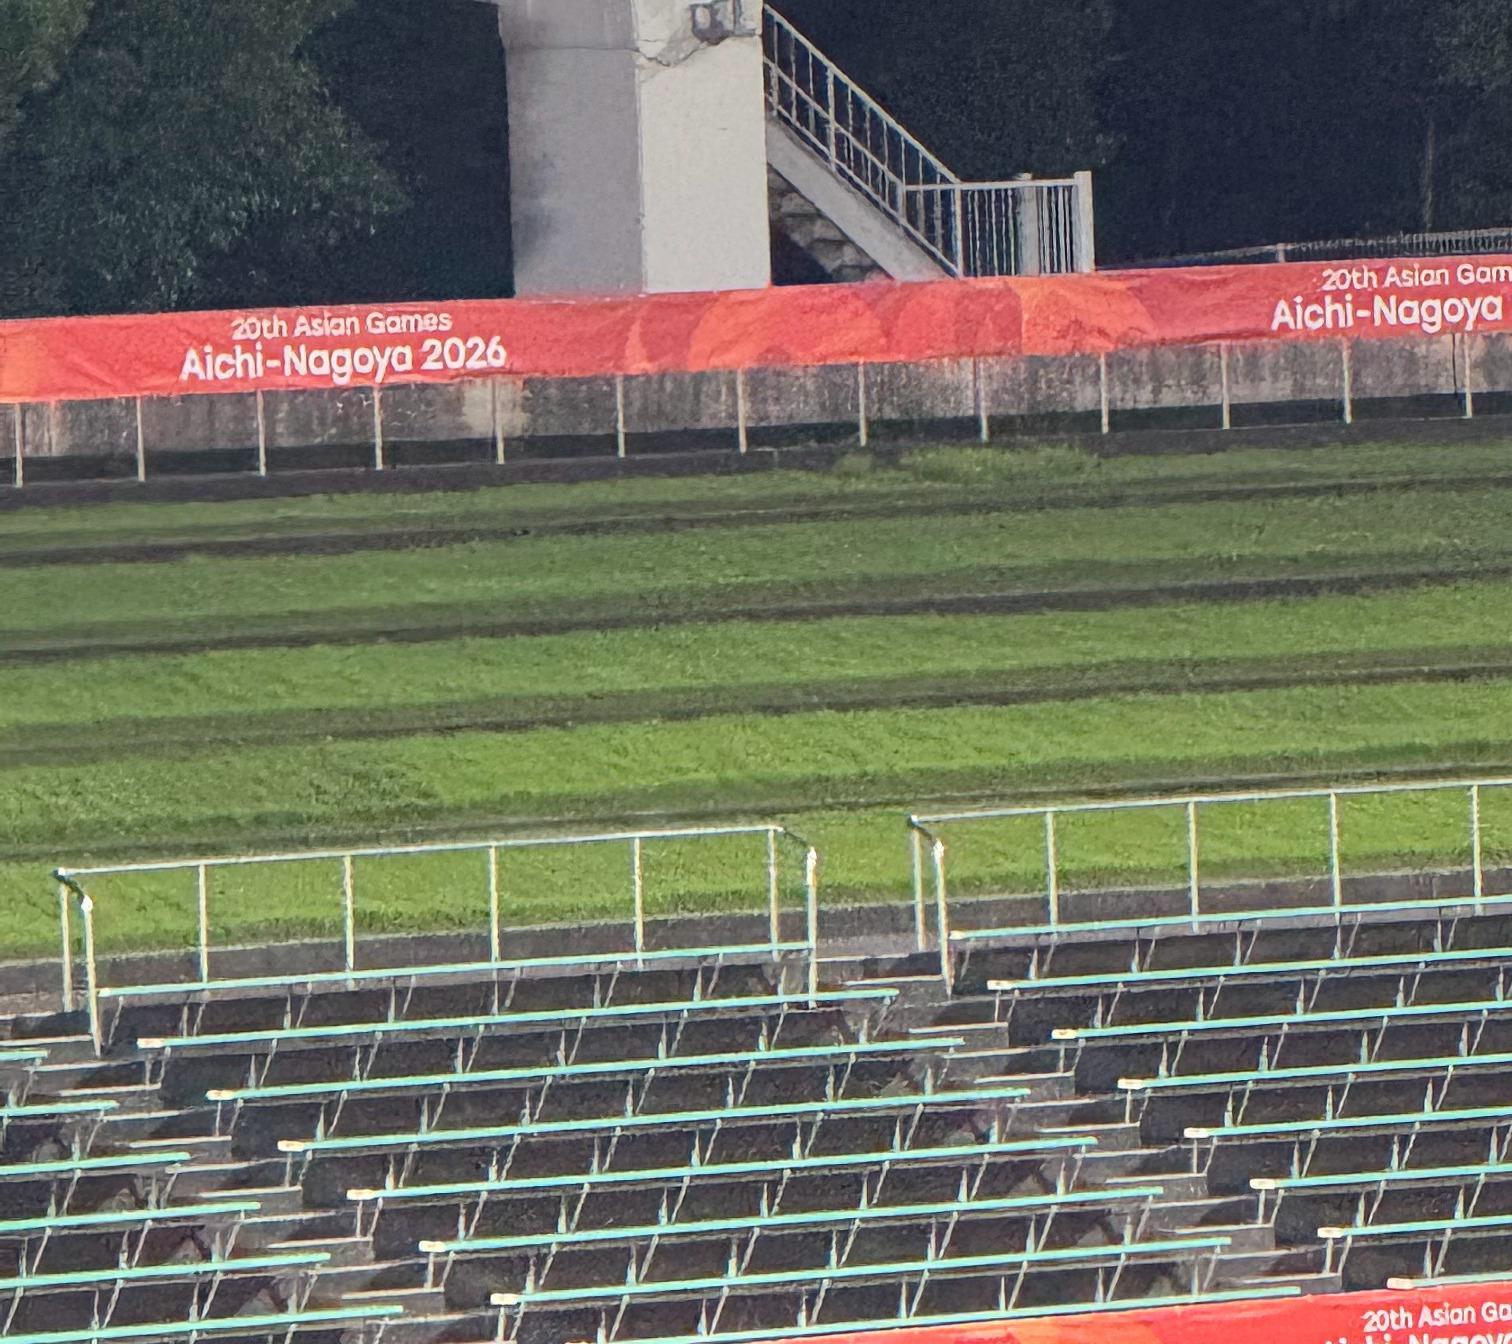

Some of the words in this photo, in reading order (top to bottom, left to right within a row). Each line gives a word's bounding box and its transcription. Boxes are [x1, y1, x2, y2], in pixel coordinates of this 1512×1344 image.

[1321, 265, 1378, 291] 20th
[1384, 264, 1450, 288] Asian
[231, 314, 289, 341] 20th
[294, 313, 361, 338] Asian
[366, 312, 453, 335] Games
[1271, 293, 1503, 334] Aichi-Nagoya
[180, 341, 414, 386] Aichi-Nagoya
[421, 336, 508, 371] 2026
[1361, 1308, 1413, 1333] 20th
[1418, 1302, 1476, 1328] Asian
